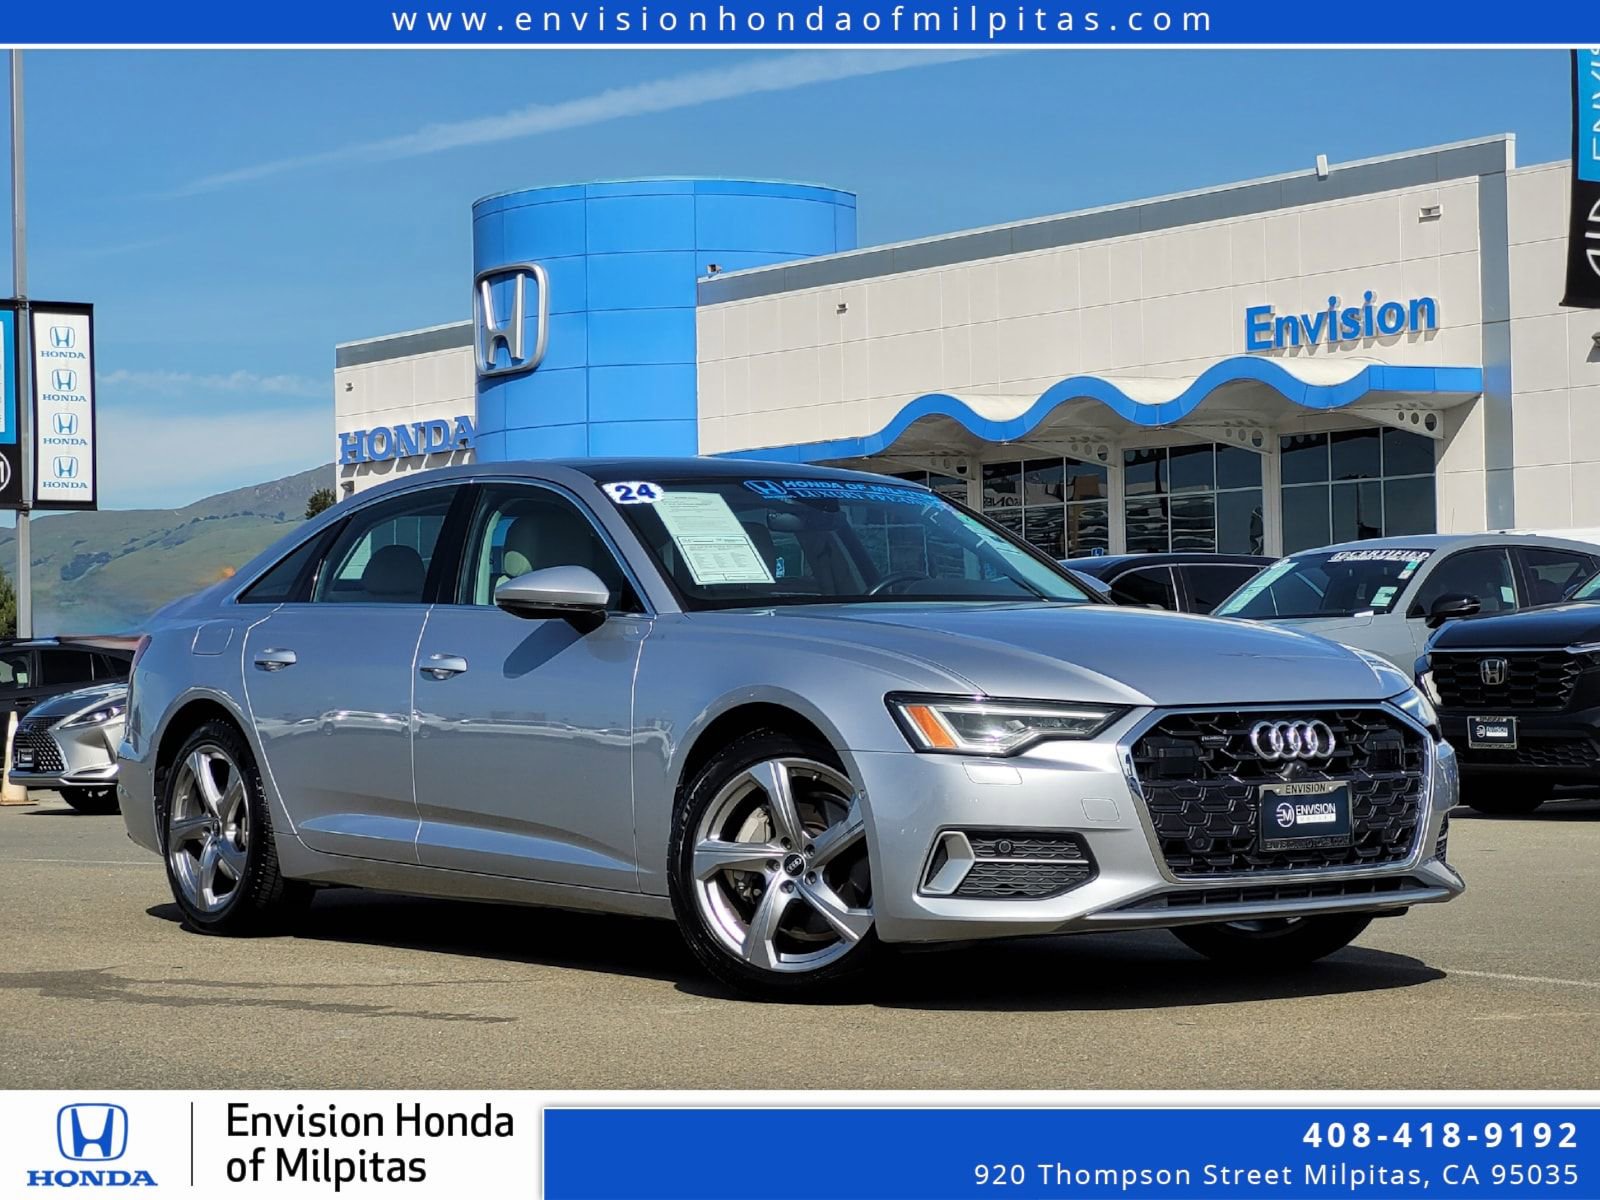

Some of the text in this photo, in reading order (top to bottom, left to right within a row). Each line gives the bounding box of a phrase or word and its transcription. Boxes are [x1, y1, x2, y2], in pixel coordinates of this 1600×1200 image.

[1246, 290, 1435, 352] Envision
[40, 351, 87, 359] HONDA
[43, 394, 88, 402] HONDA
[338, 415, 477, 465] HONDA
[615, 484, 656, 501] 24
[1285, 783, 1326, 794] ENVISION
[1295, 803, 1336, 815] ENVISION
